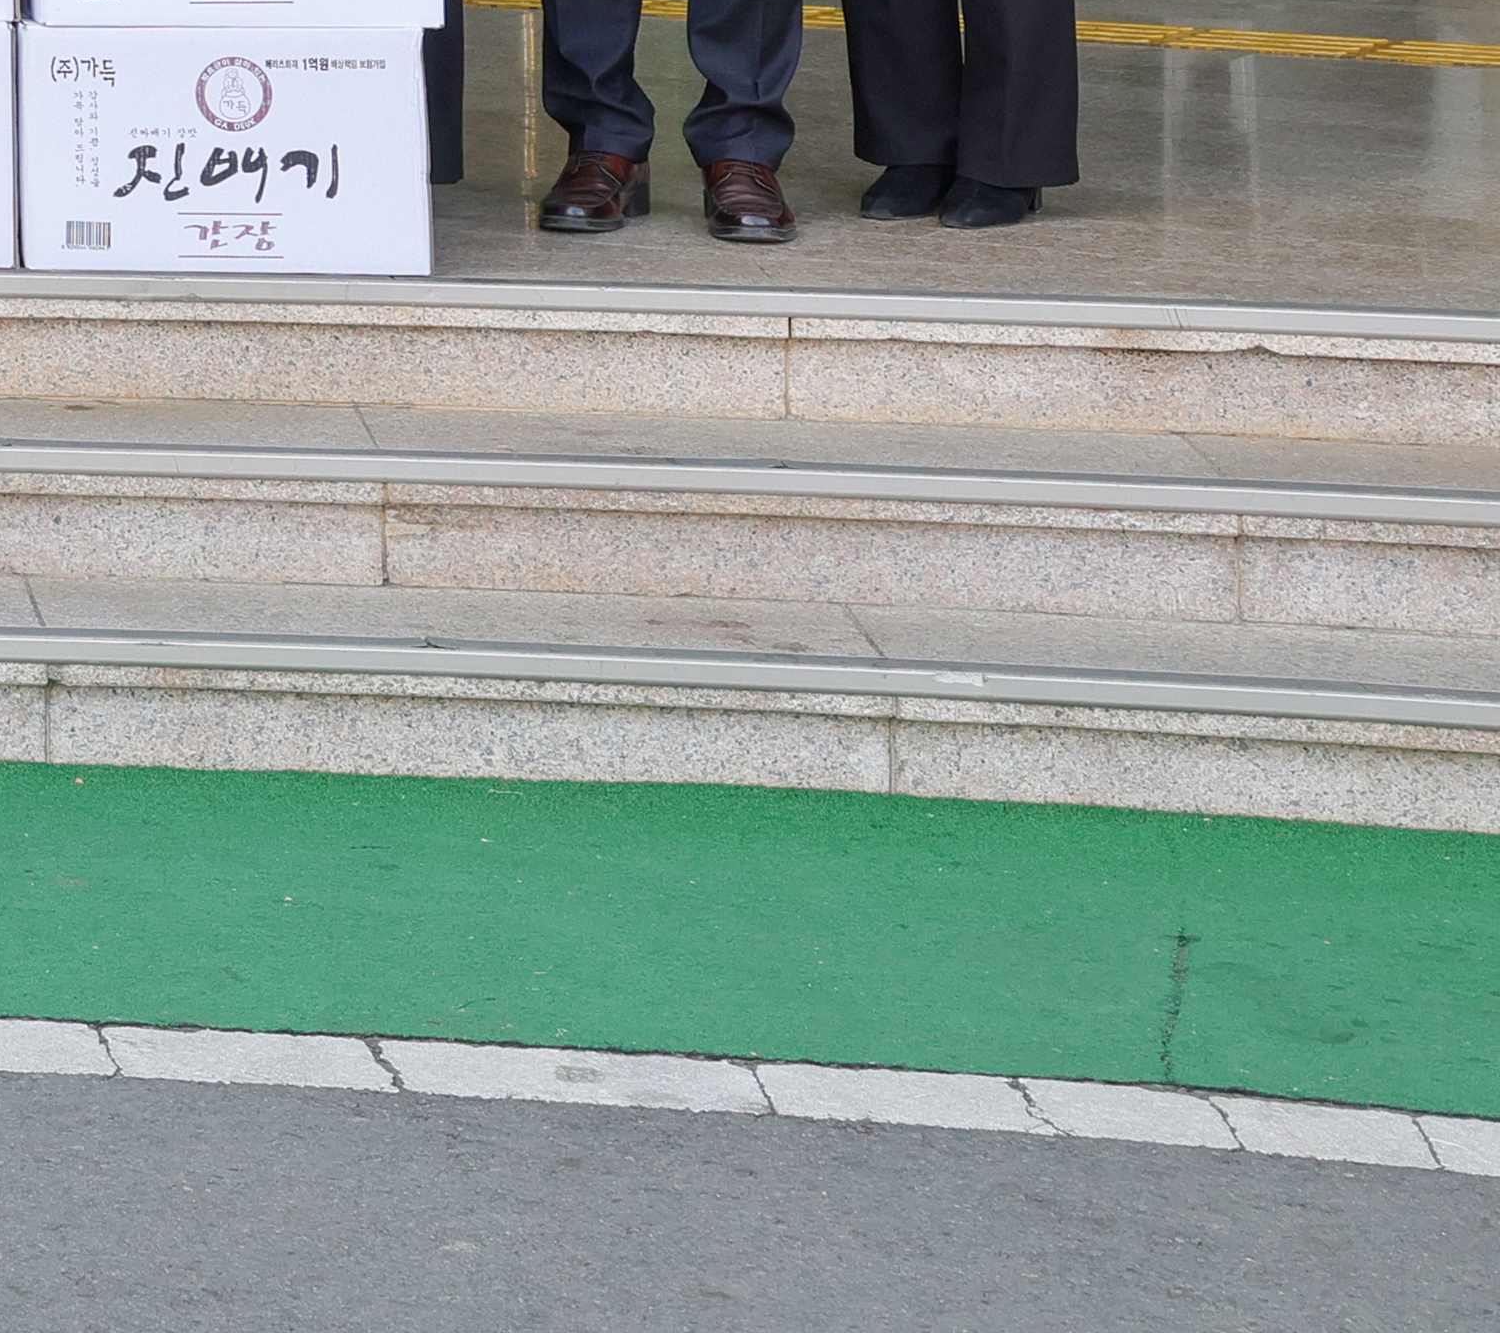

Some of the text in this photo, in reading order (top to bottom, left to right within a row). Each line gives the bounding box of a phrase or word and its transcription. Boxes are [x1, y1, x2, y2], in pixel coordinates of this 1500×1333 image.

[49, 55, 117, 88] (주)가득
[115, 141, 348, 209] 진배기
[183, 219, 279, 253] 간장
